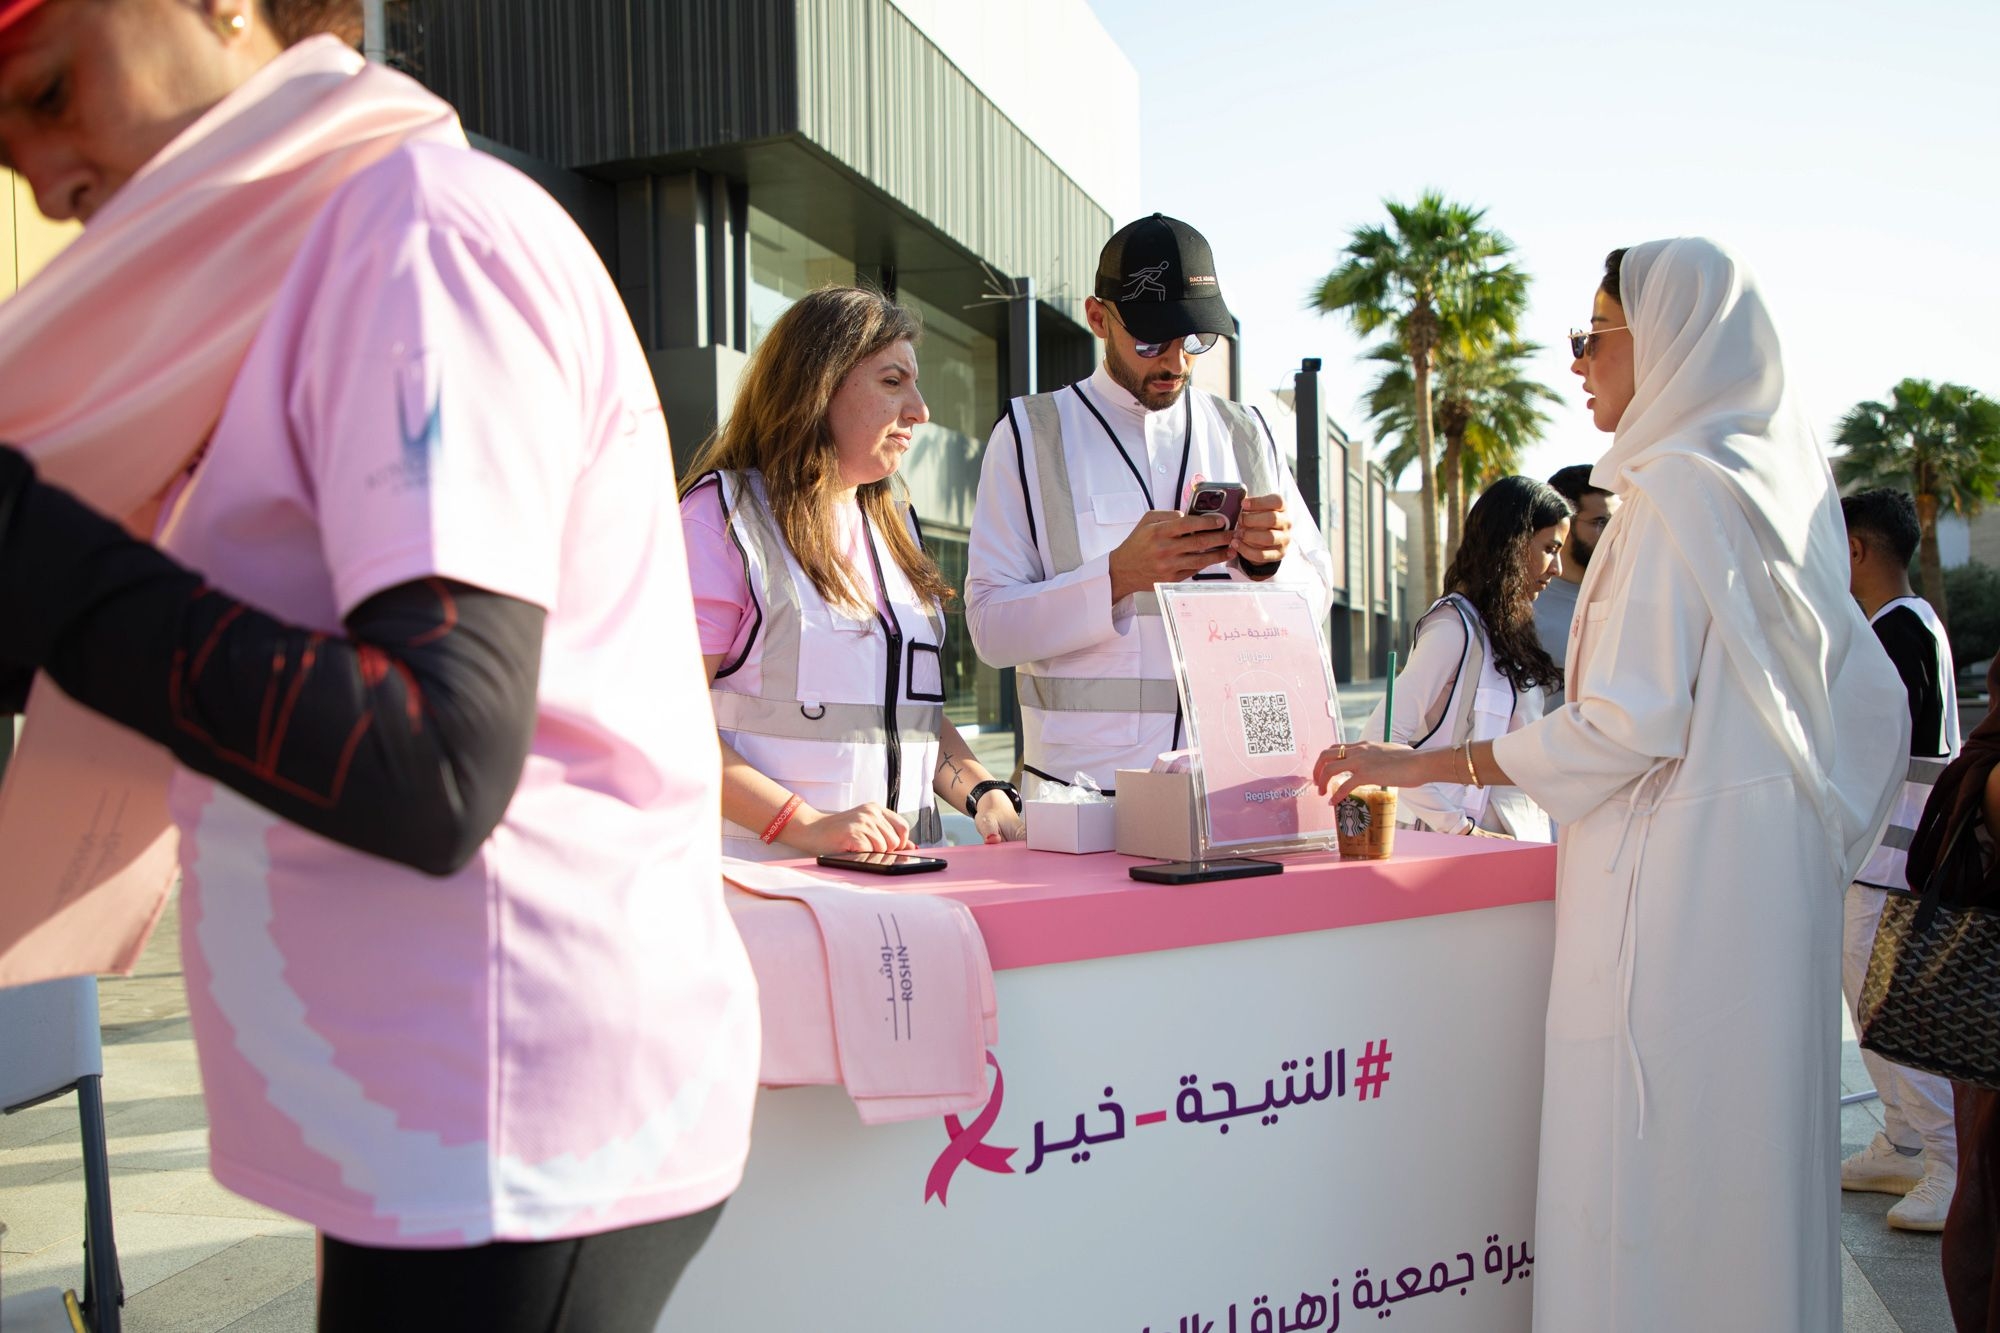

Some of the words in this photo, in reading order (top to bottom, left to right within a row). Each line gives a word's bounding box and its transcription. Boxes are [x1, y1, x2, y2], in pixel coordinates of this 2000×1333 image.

[1245, 790, 1284, 803] Register
[896, 945, 913, 1001] ROSHN
[1352, 1252, 1475, 1319] جمعية
[1484, 1233, 1535, 1285] يرة
[1250, 1278, 1340, 1333] زهرة
